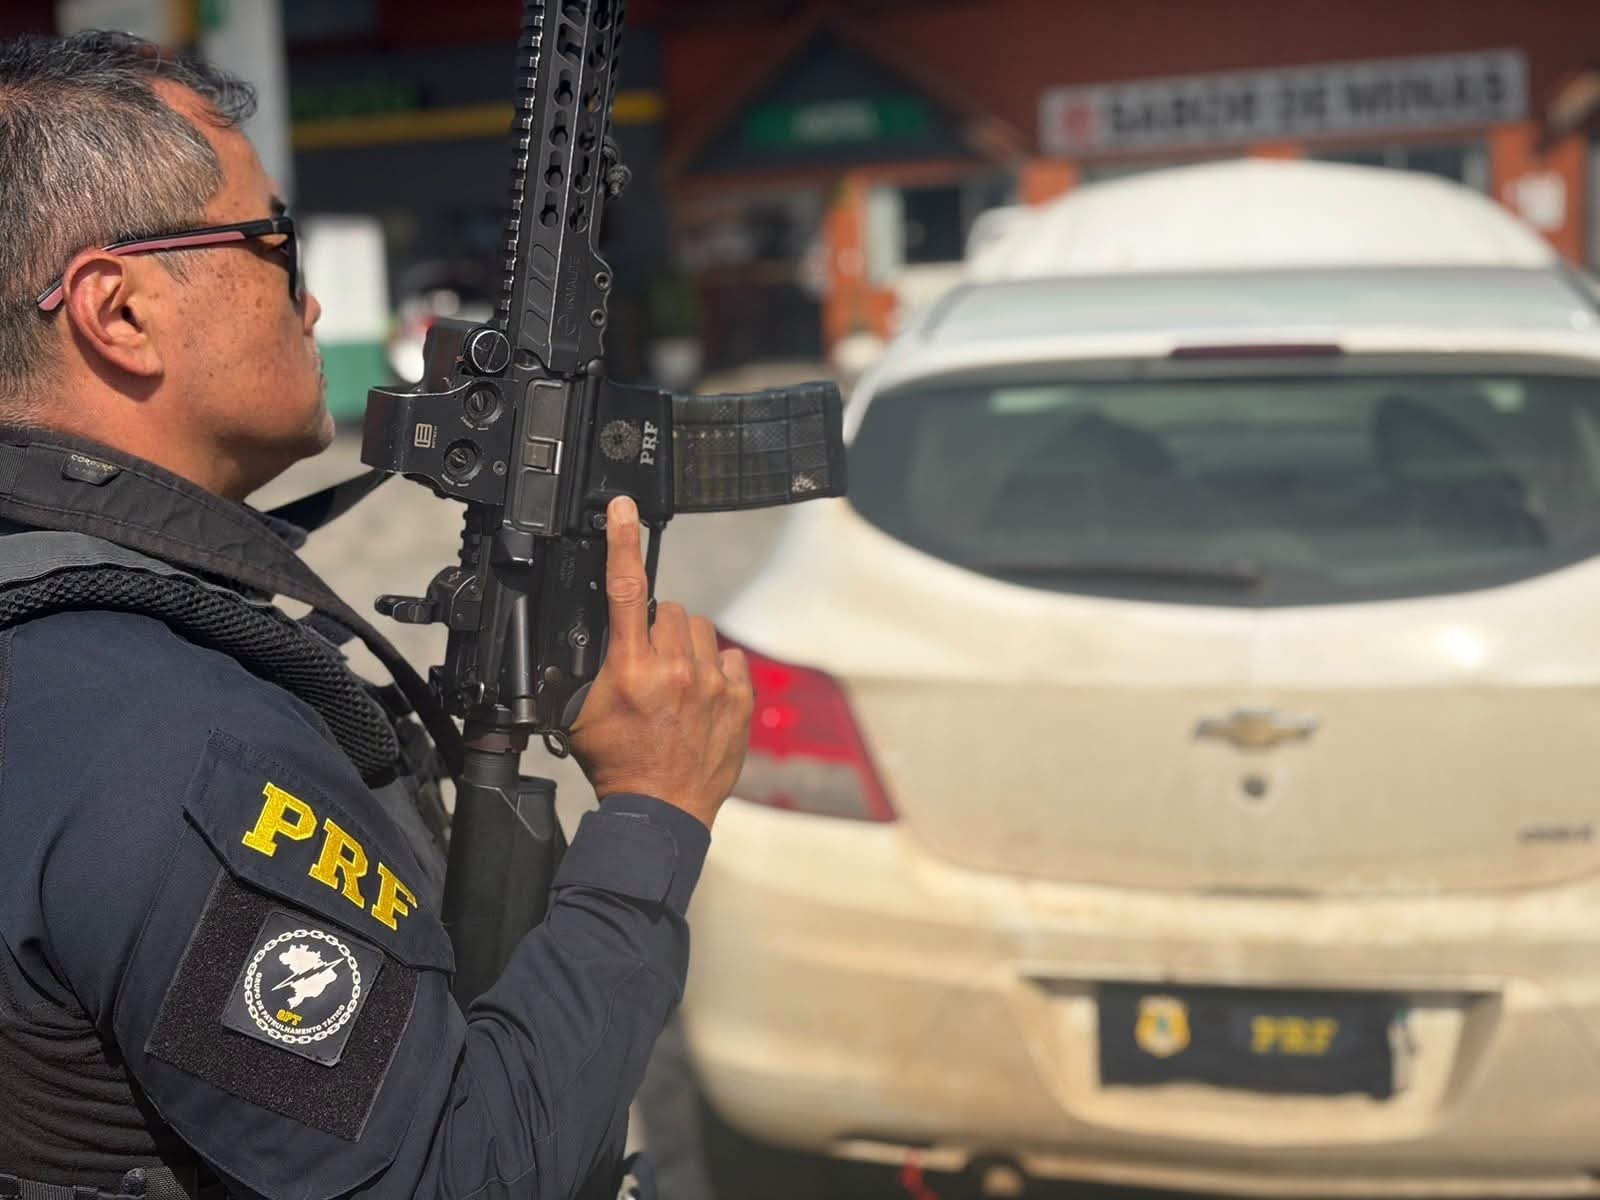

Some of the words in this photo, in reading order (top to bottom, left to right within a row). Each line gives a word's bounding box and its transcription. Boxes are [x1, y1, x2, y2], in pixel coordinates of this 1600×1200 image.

[1277, 84, 1330, 122] DE
[640, 421, 659, 465] PRF
[241, 781, 418, 931] PRF
[254, 972, 263, 999] GRUPO
[260, 1010, 322, 1034] PATRULHAMENTO
[321, 1004, 345, 1029] TÁTICO
[1250, 1014, 1340, 1056] PRF
